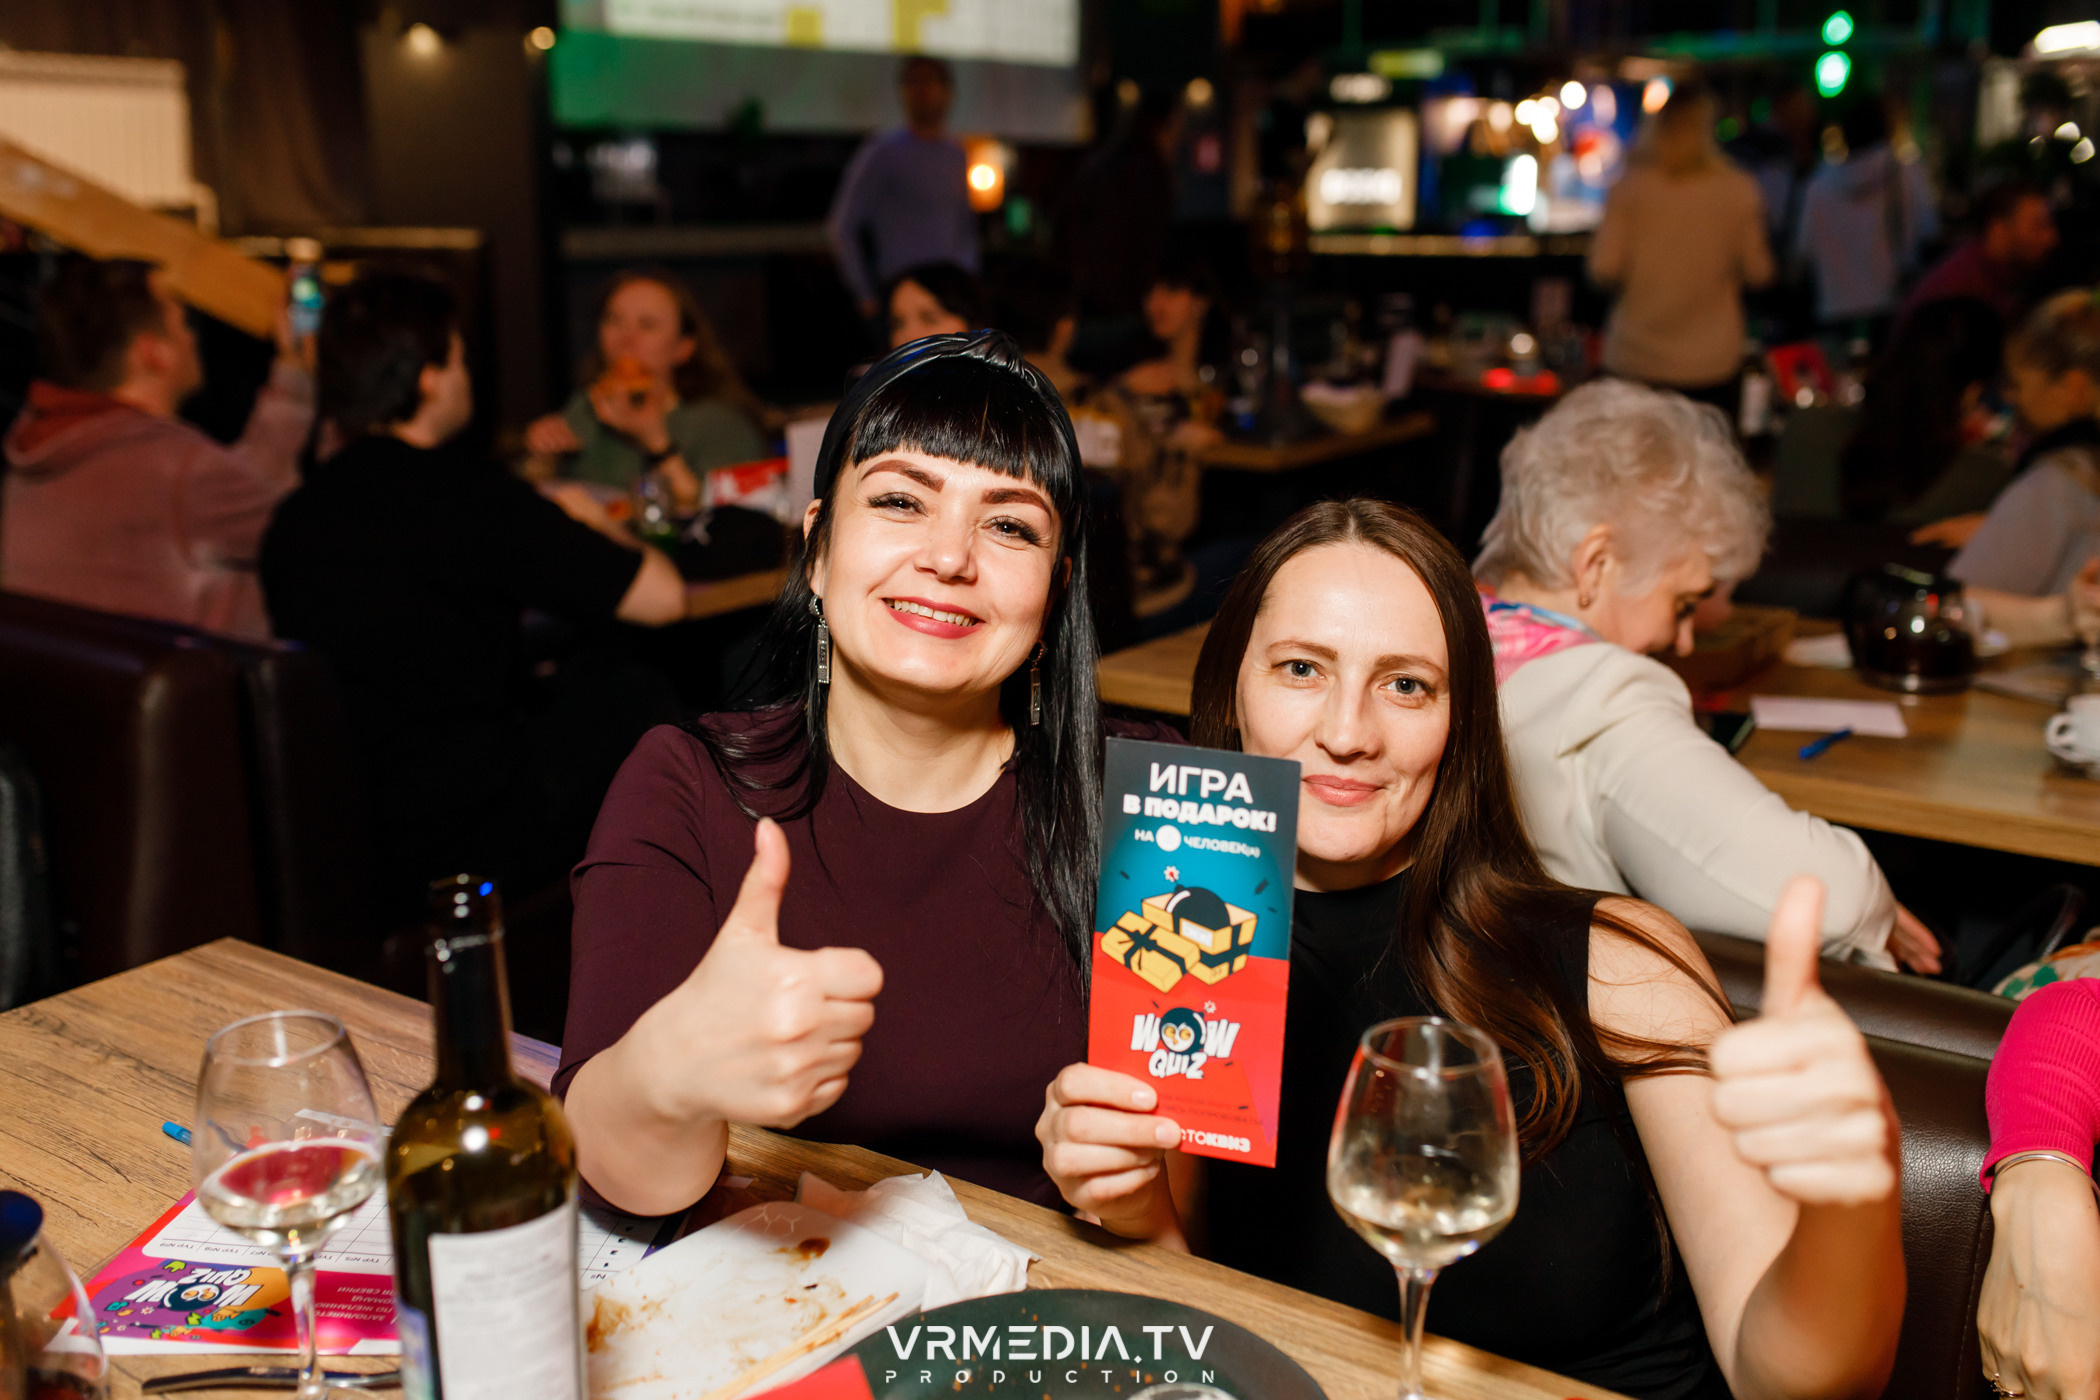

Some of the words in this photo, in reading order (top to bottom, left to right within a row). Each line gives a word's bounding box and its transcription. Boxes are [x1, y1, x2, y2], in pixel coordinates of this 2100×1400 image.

[1150, 762, 1254, 804] ИГРА
[1122, 793, 1141, 815] В
[1144, 796, 1277, 832] ПОДАРОК!
[1134, 828, 1155, 843] НА
[1130, 1007, 1241, 1058] WOW
[1148, 1049, 1208, 1079] QUIZ
[178, 1268, 252, 1286] QUIZ
